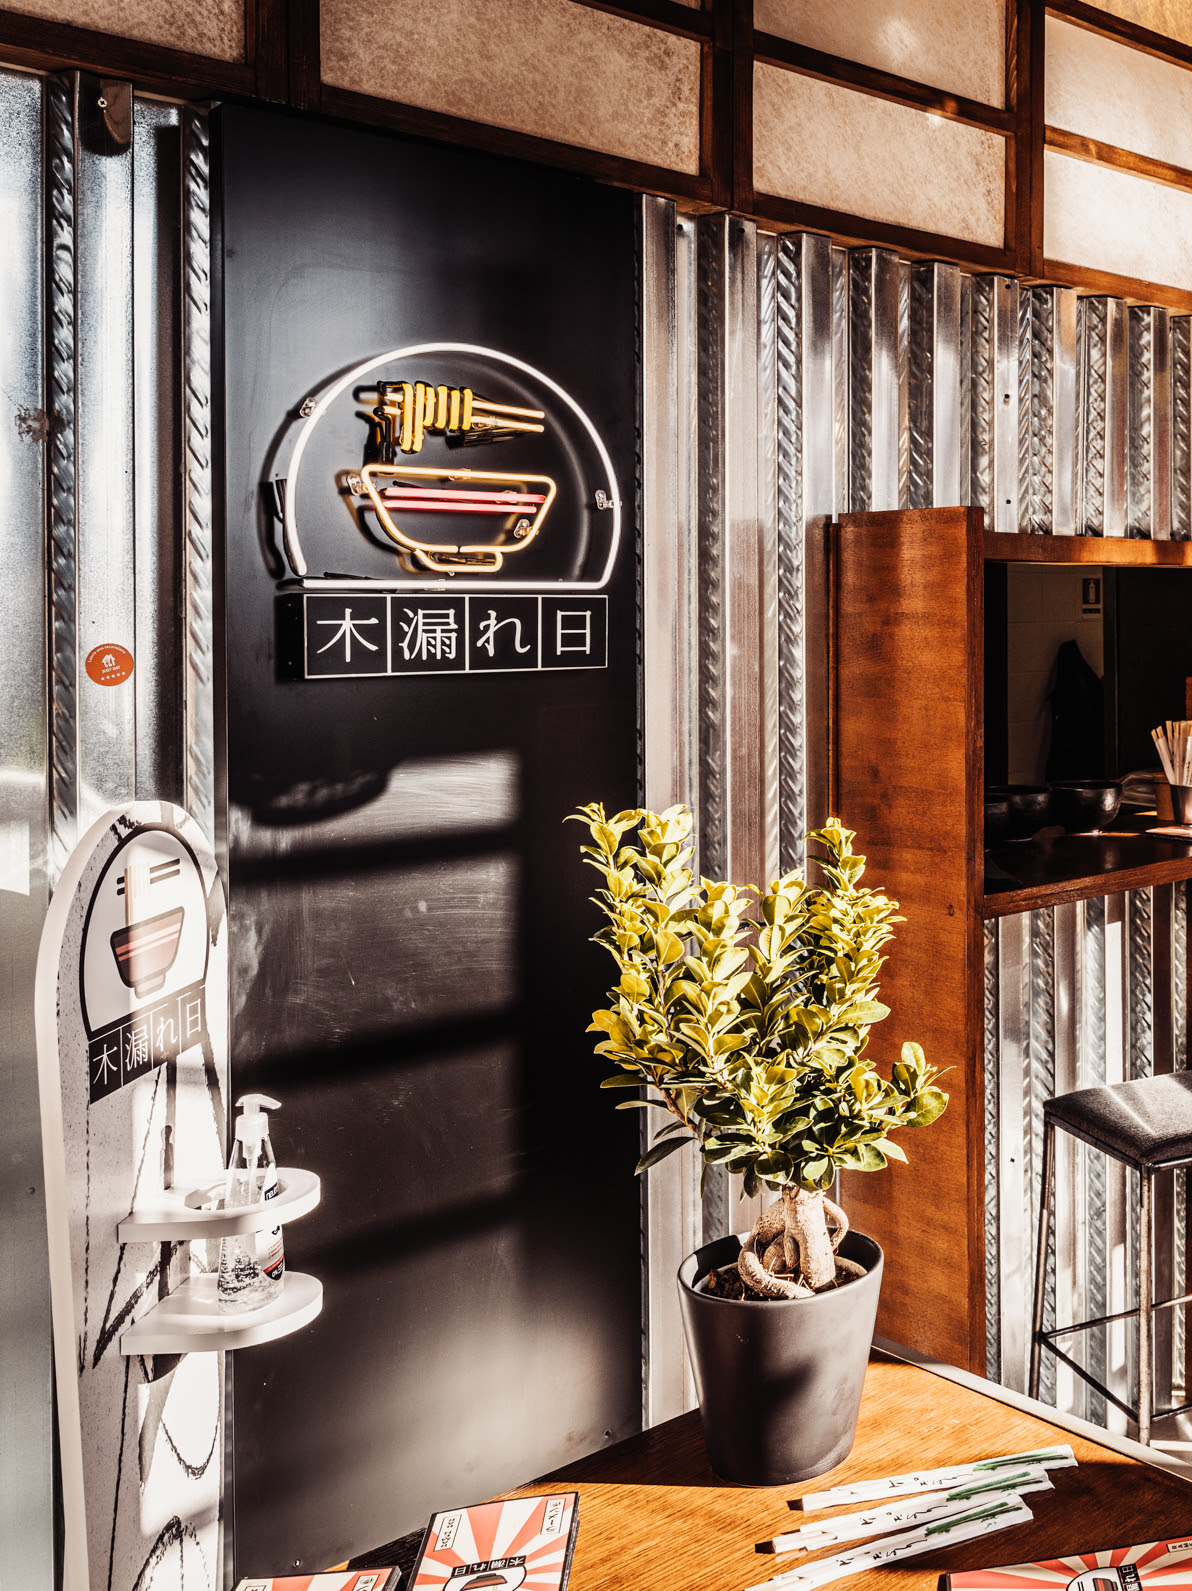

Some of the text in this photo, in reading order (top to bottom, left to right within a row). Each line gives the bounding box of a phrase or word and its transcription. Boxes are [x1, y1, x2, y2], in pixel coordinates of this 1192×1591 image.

[316, 607, 592, 663] 木漏れ日
[92, 998, 202, 1086] 木漏れ日
